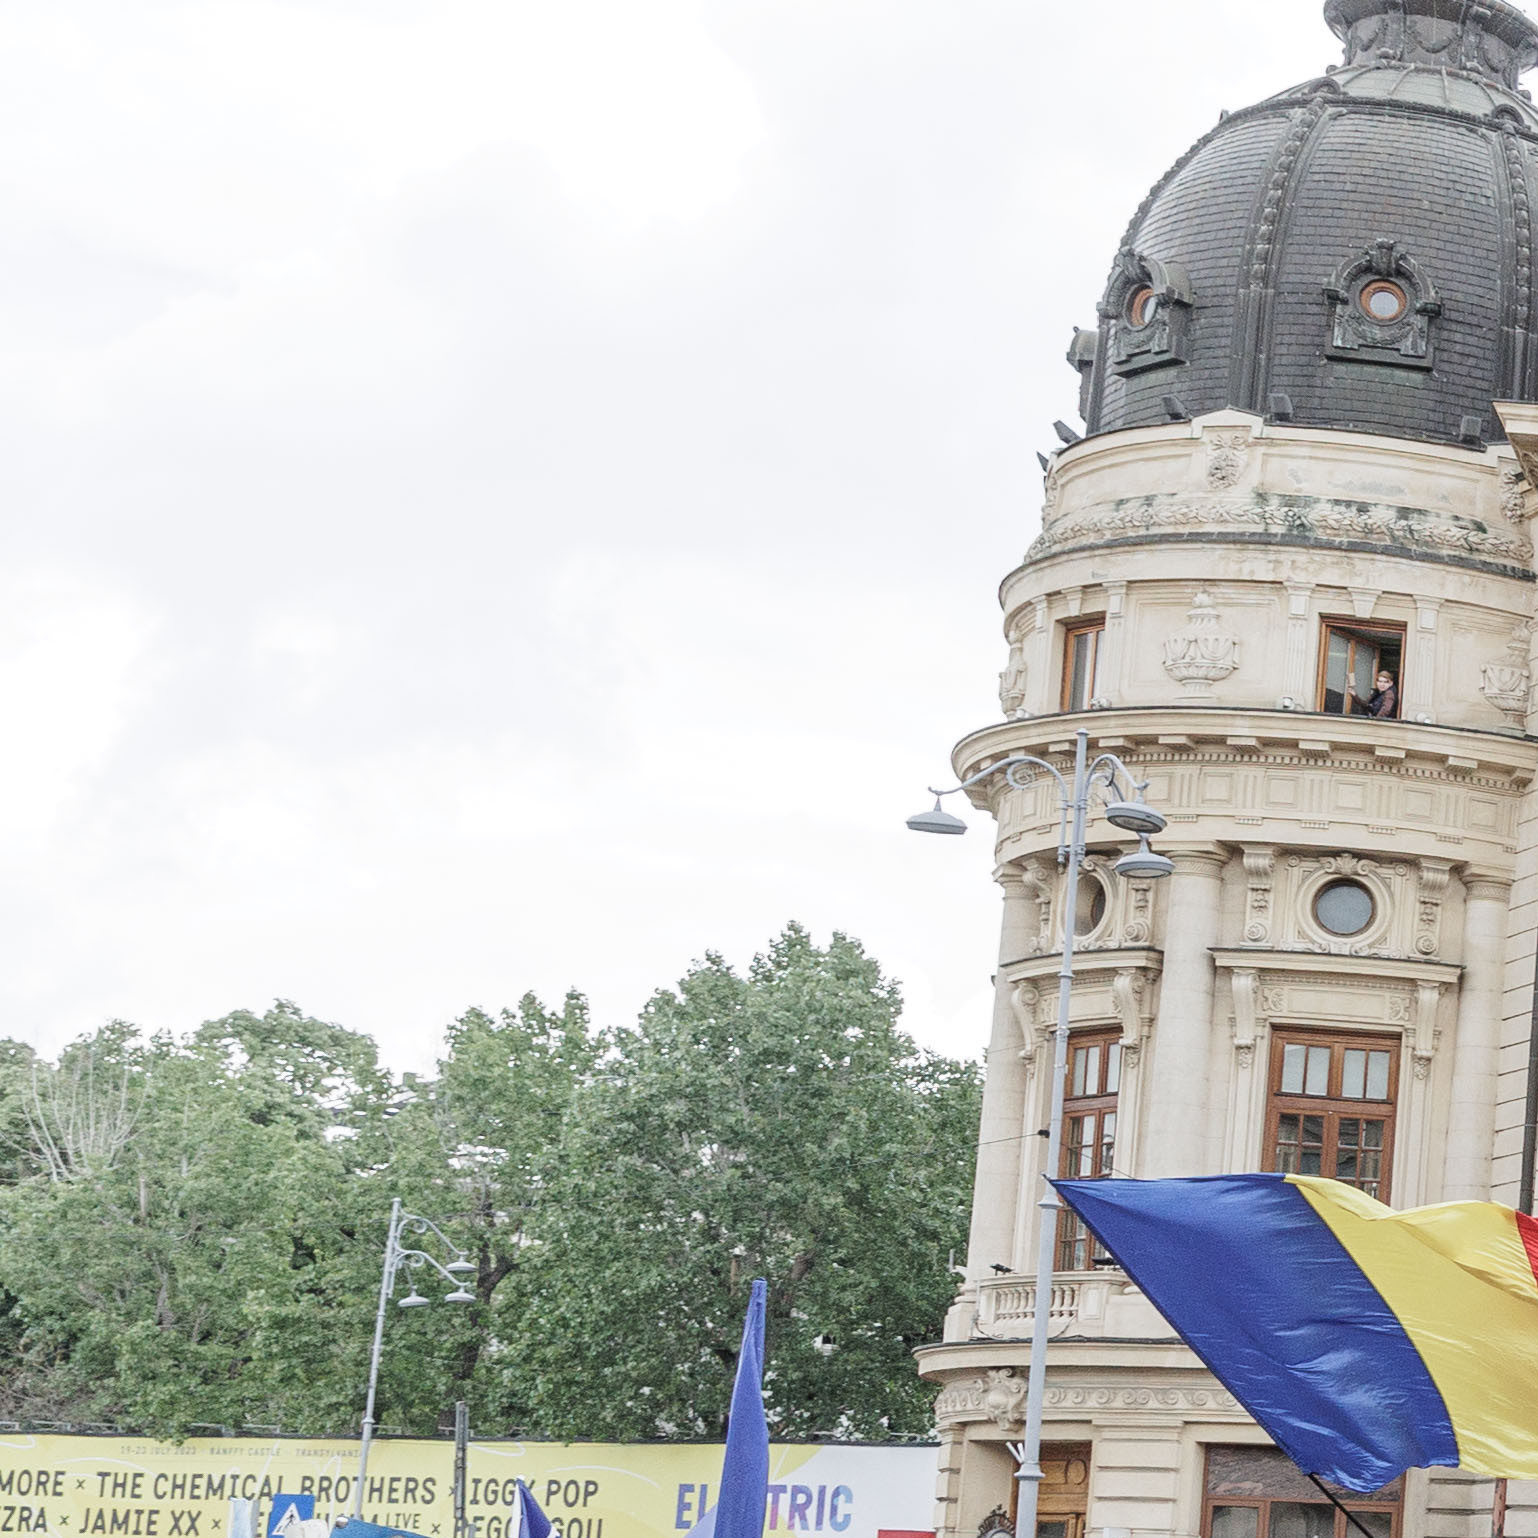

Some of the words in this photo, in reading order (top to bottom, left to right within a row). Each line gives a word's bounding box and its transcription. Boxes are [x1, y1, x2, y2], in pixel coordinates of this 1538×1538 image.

[99, 1472, 145, 1499] THE
[153, 1472, 285, 1501] CHEMICAL
[545, 1479, 600, 1508] POP
[0, 1506, 49, 1533] ZRA
[79, 1507, 159, 1536] JAMIE
[168, 1509, 203, 1537] XX
